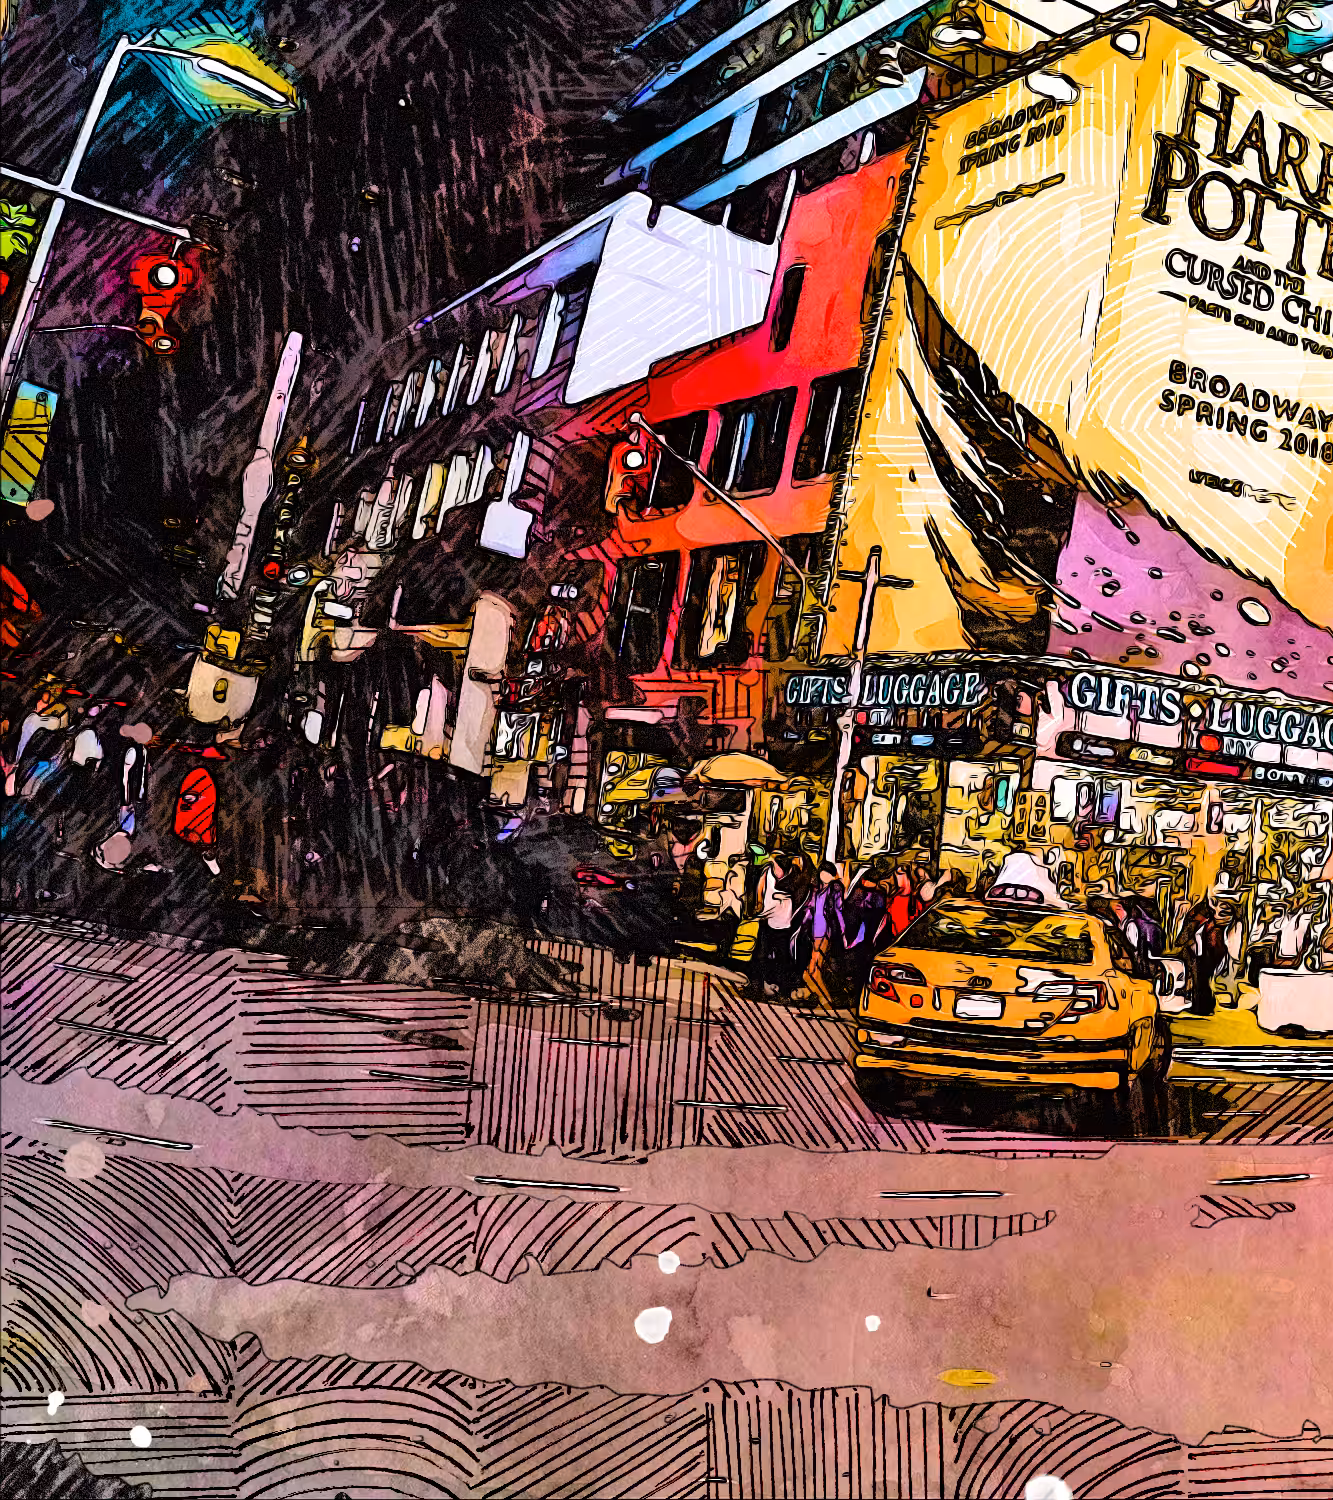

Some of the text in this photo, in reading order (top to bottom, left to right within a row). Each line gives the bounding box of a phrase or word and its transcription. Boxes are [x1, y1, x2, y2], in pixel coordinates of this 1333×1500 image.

[1164, 247, 1275, 312] CURSED
[1233, 255, 1271, 281] AND
[1158, 388, 1269, 443] SPRING
[785, 671, 982, 709] GIFTS LUGGAGE
[1070, 671, 1182, 724] GIFTS
